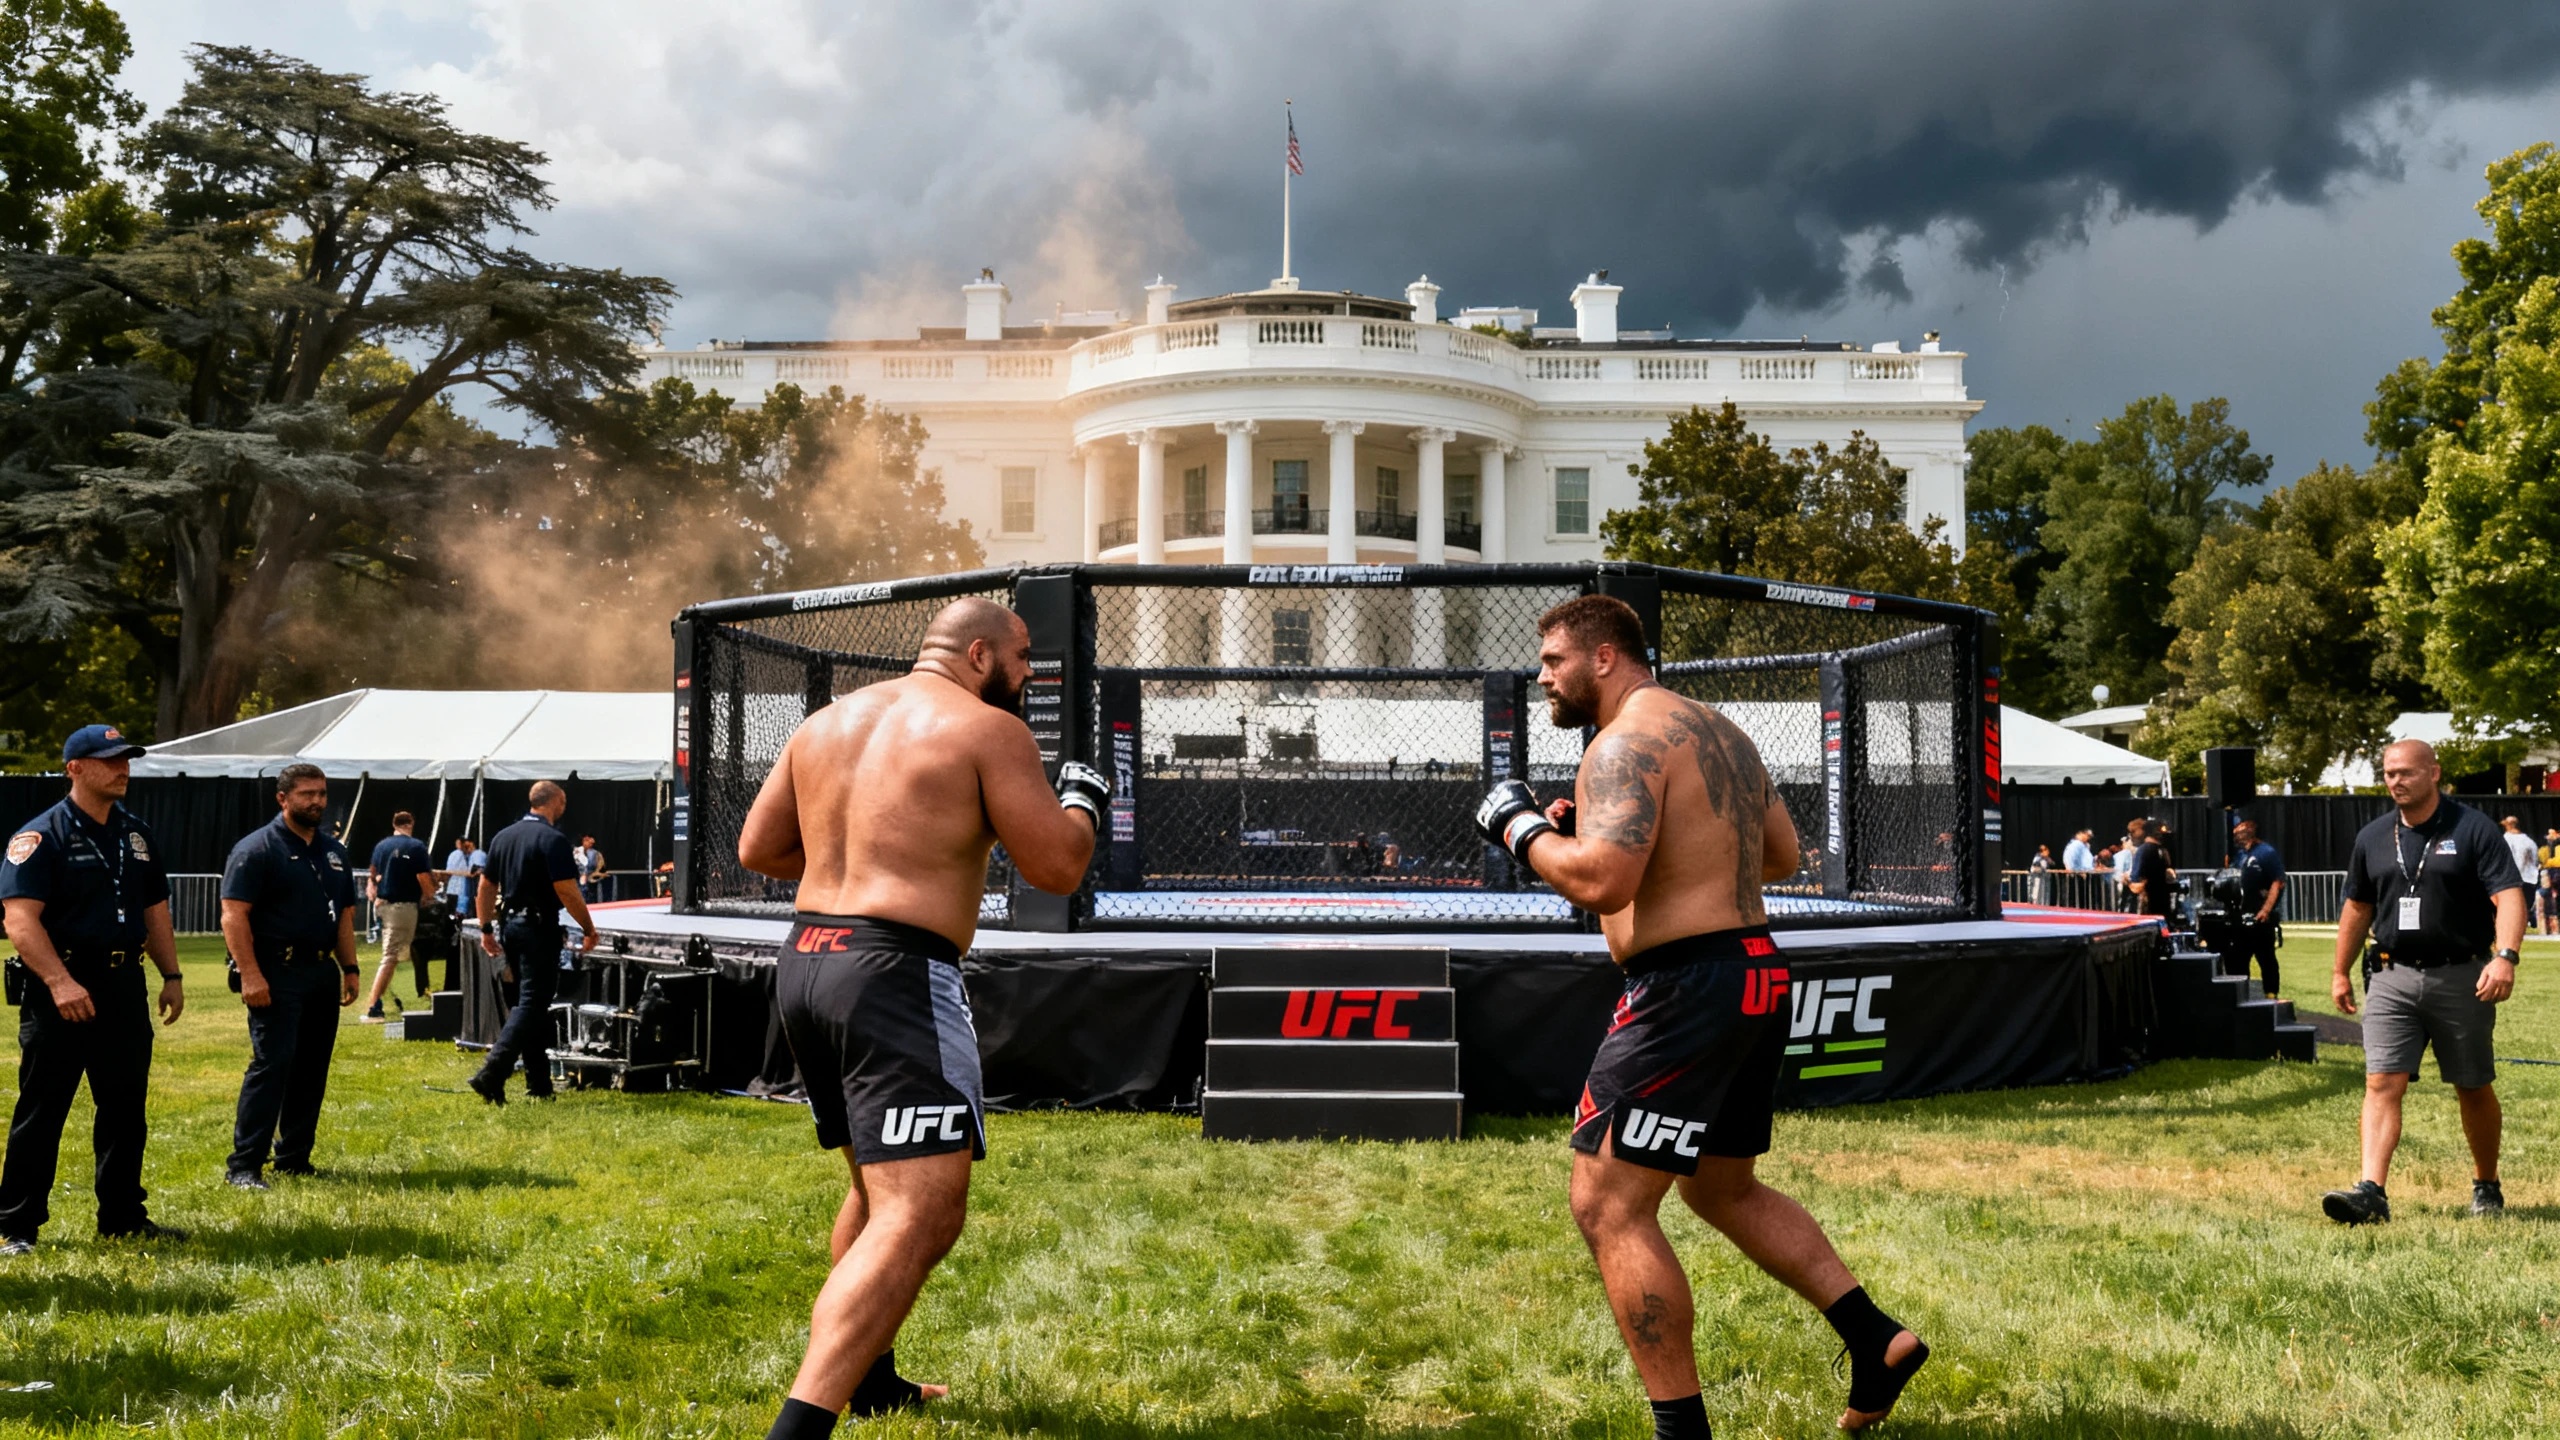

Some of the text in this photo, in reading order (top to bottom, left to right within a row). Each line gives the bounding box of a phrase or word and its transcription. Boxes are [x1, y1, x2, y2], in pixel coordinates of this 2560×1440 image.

[795, 926, 853, 953] UFC
[1281, 989, 1419, 1039] UFC
[1789, 975, 1893, 1038] UFC
[881, 1104, 968, 1145] UFC
[1621, 1108, 1708, 1158] UFC
